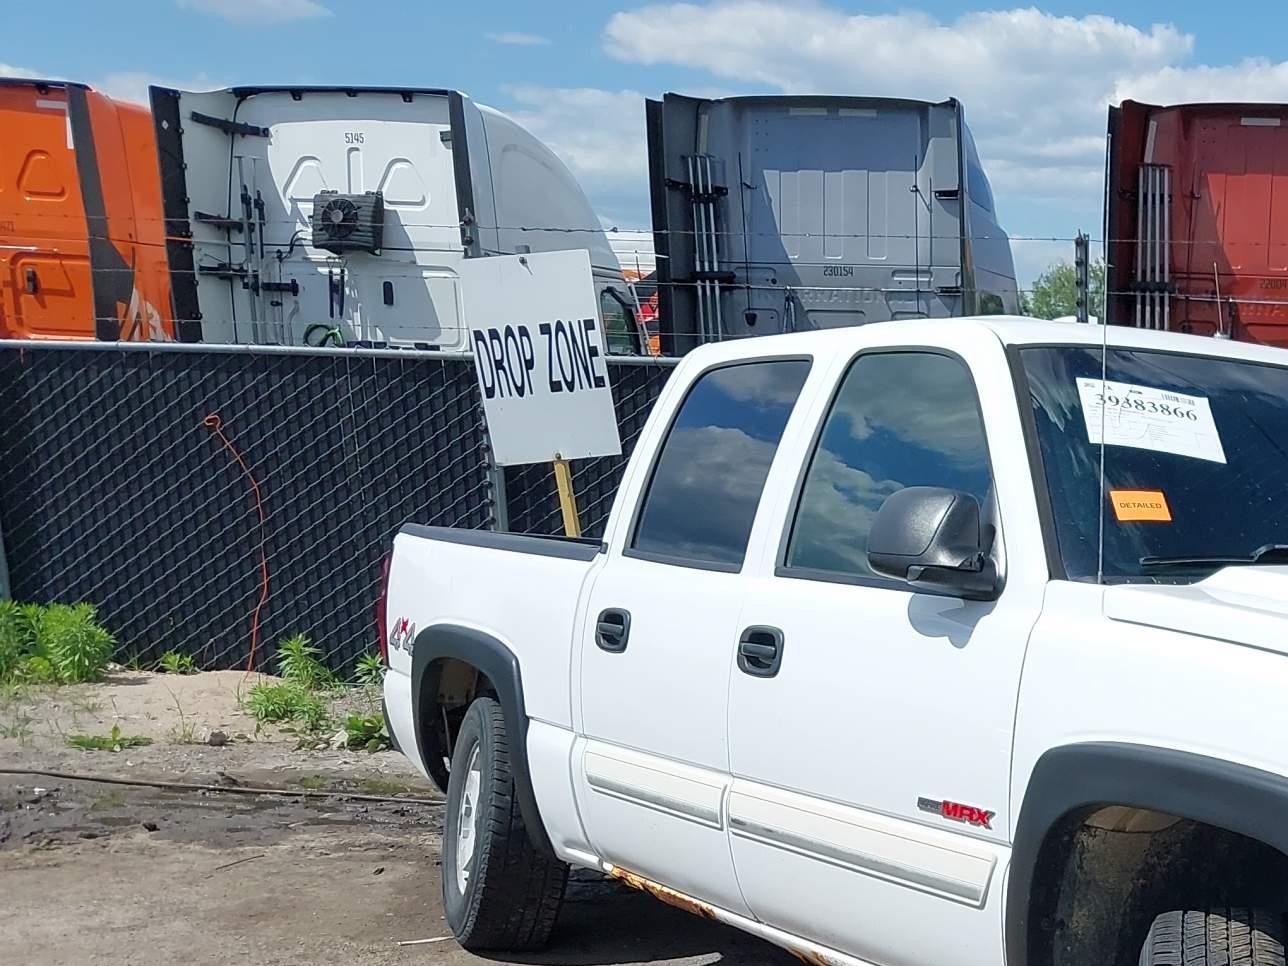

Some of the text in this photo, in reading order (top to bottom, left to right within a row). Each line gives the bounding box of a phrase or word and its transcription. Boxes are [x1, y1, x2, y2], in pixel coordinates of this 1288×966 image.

[344, 132, 365, 144] 5145
[823, 265, 854, 277] 230154
[473, 318, 607, 399] DROP ZONE
[1095, 393, 1198, 422] 39383866
